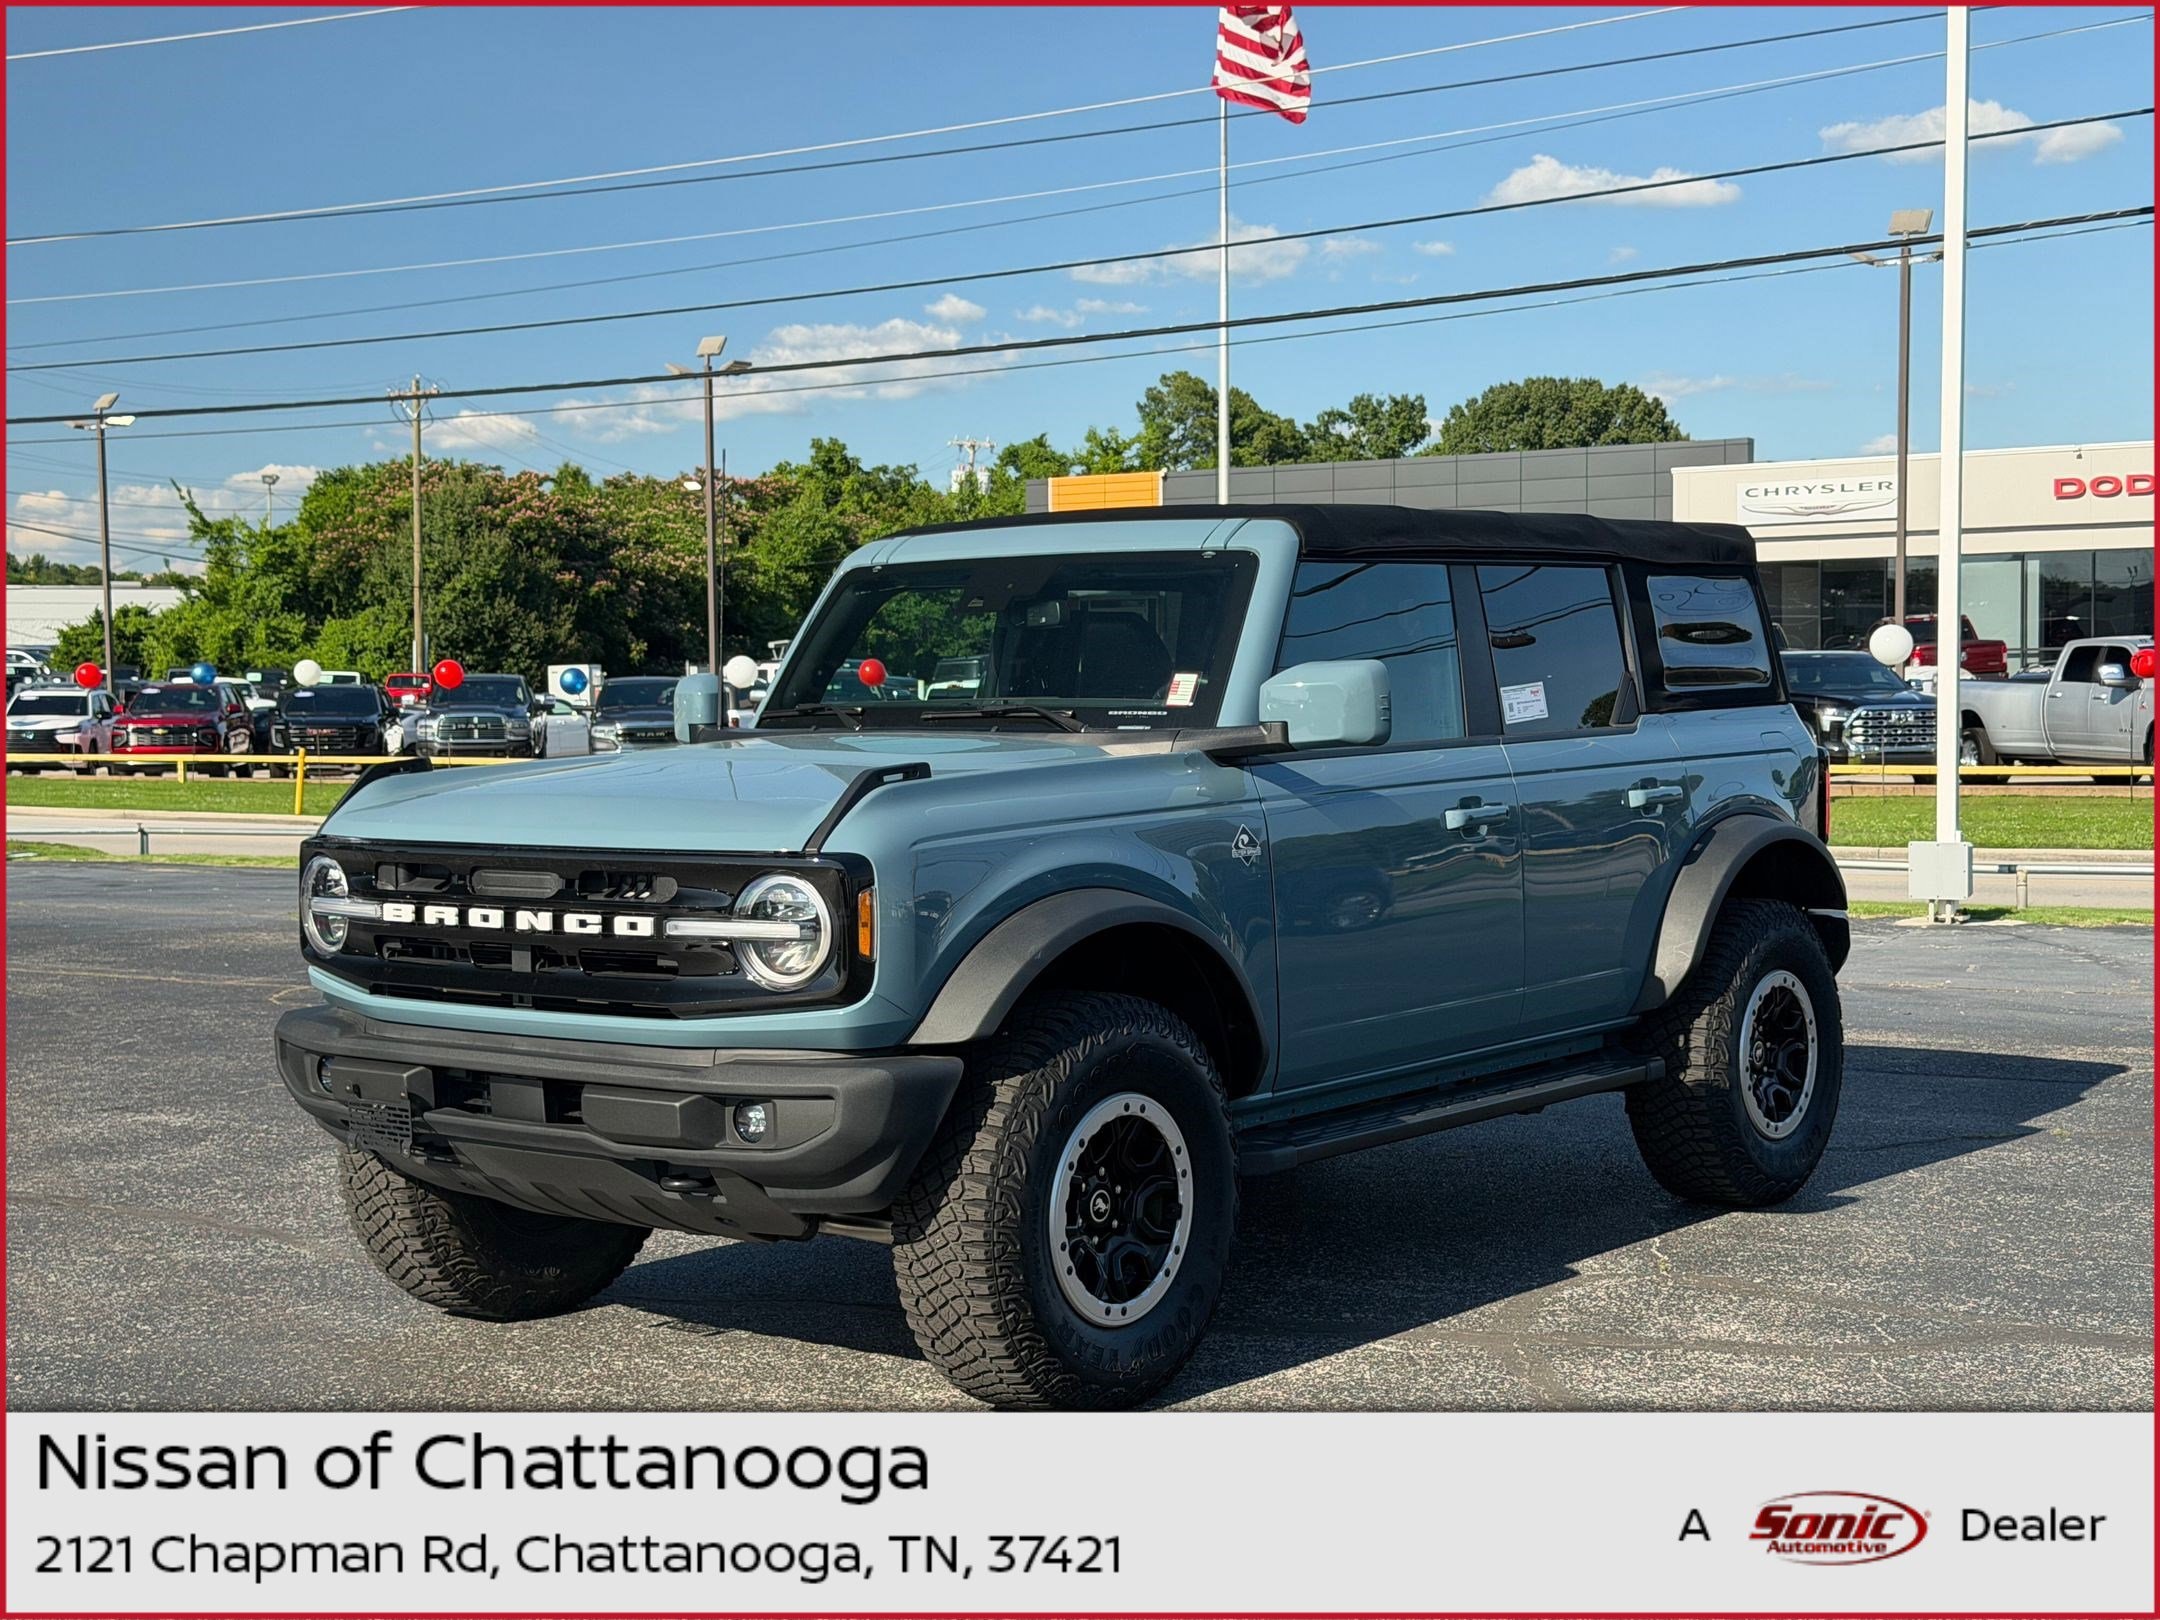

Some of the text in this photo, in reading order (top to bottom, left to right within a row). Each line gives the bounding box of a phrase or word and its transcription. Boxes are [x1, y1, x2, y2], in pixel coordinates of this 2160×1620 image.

[1745, 481, 1894, 498] CHRYSLER
[2053, 475, 2154, 500] DOD
[382, 902, 656, 937] BRONCO
